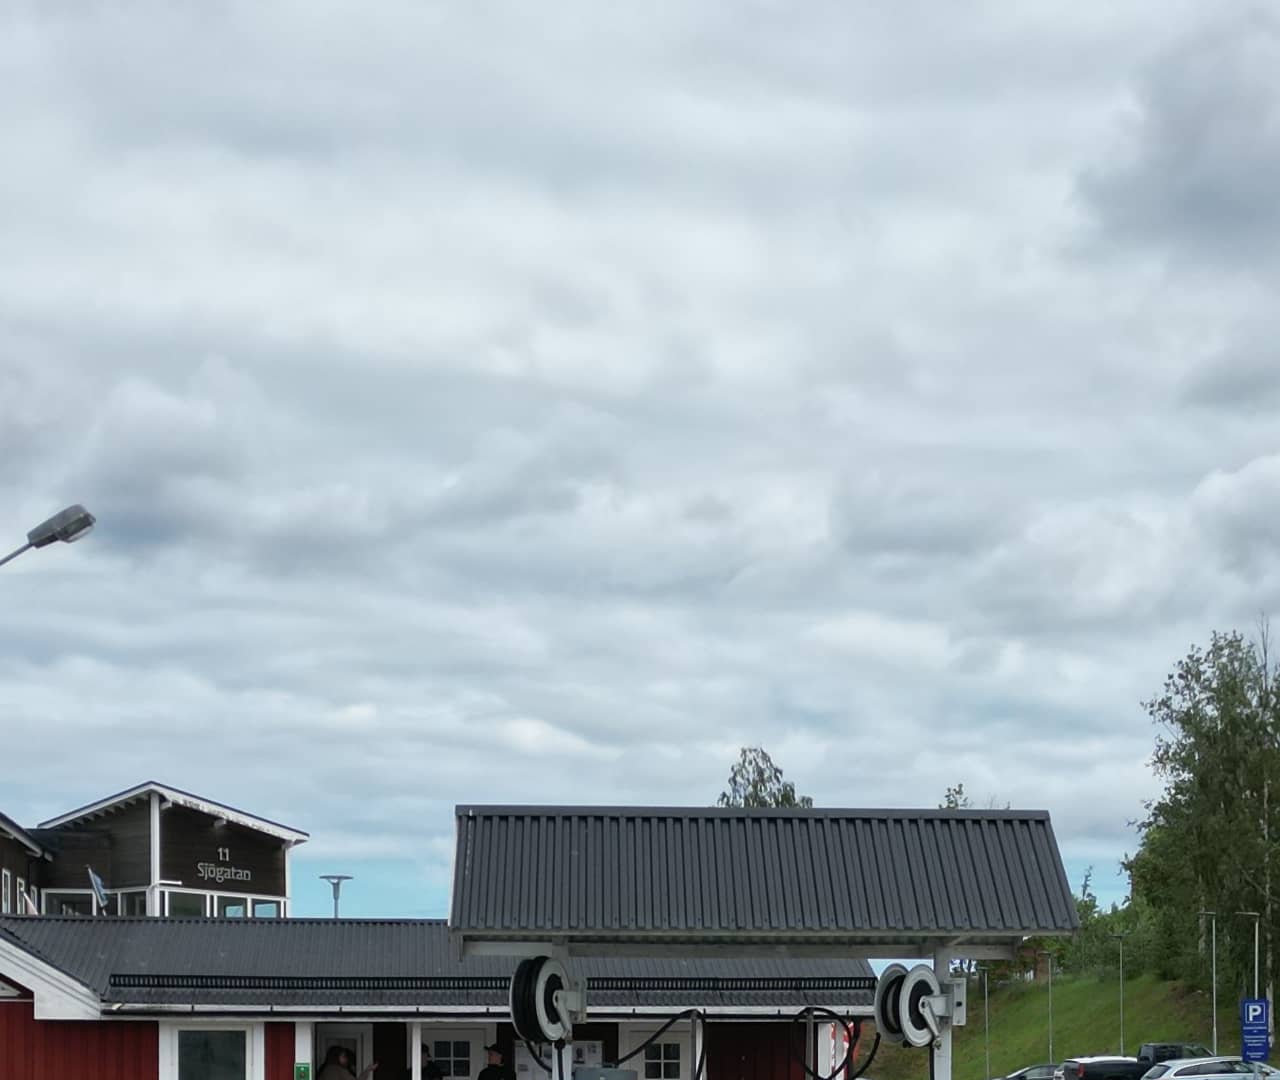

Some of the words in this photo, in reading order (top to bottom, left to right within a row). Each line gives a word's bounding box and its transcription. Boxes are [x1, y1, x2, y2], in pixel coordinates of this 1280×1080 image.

[217, 847, 230, 862] 11
[197, 862, 251, 883] Sjögatan
[1248, 1005, 1262, 1022] P
